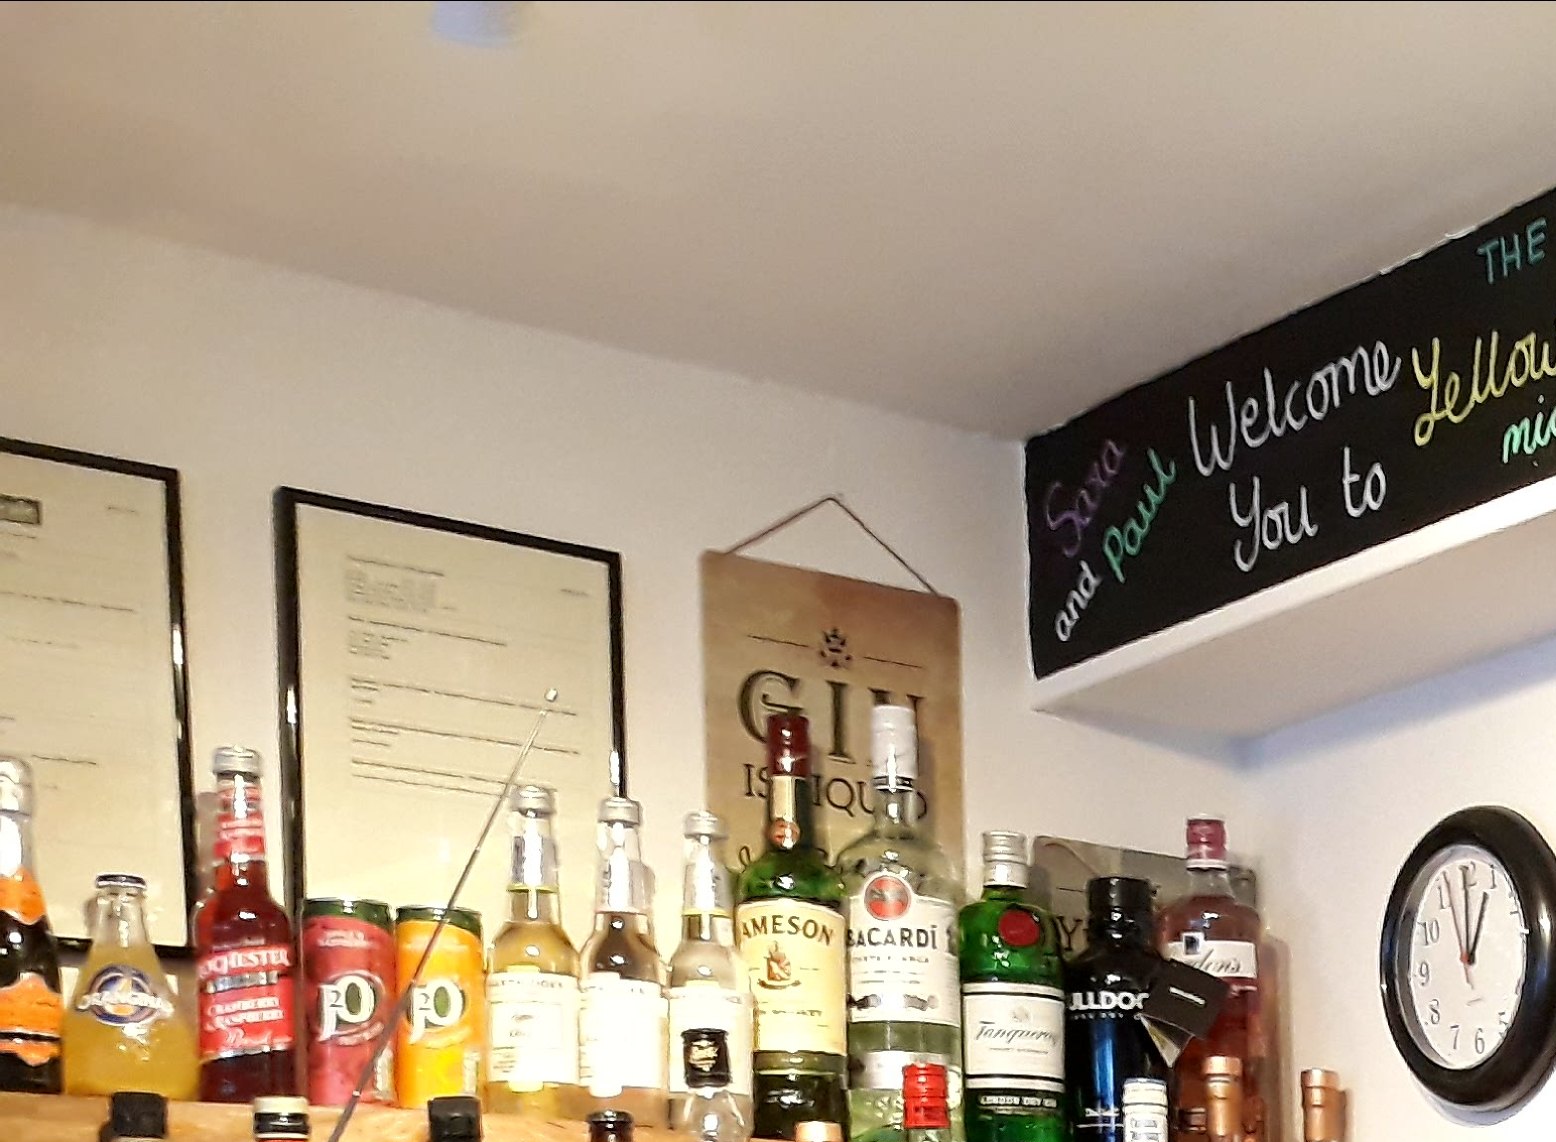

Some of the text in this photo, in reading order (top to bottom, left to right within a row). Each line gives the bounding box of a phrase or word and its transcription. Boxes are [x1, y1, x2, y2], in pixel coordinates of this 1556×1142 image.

[1477, 217, 1547, 283] THE
[1188, 339, 1400, 477] Welcome
[1228, 447, 1386, 572] You to
[1055, 564, 1101, 643] and
[742, 915, 834, 946] AMESON
[1418, 920, 1440, 946] 10
[1419, 962, 1430, 986] 9
[1429, 999, 1441, 1024] 8
[1450, 1024, 1460, 1050] 7
[1475, 1028, 1486, 1054] 6
